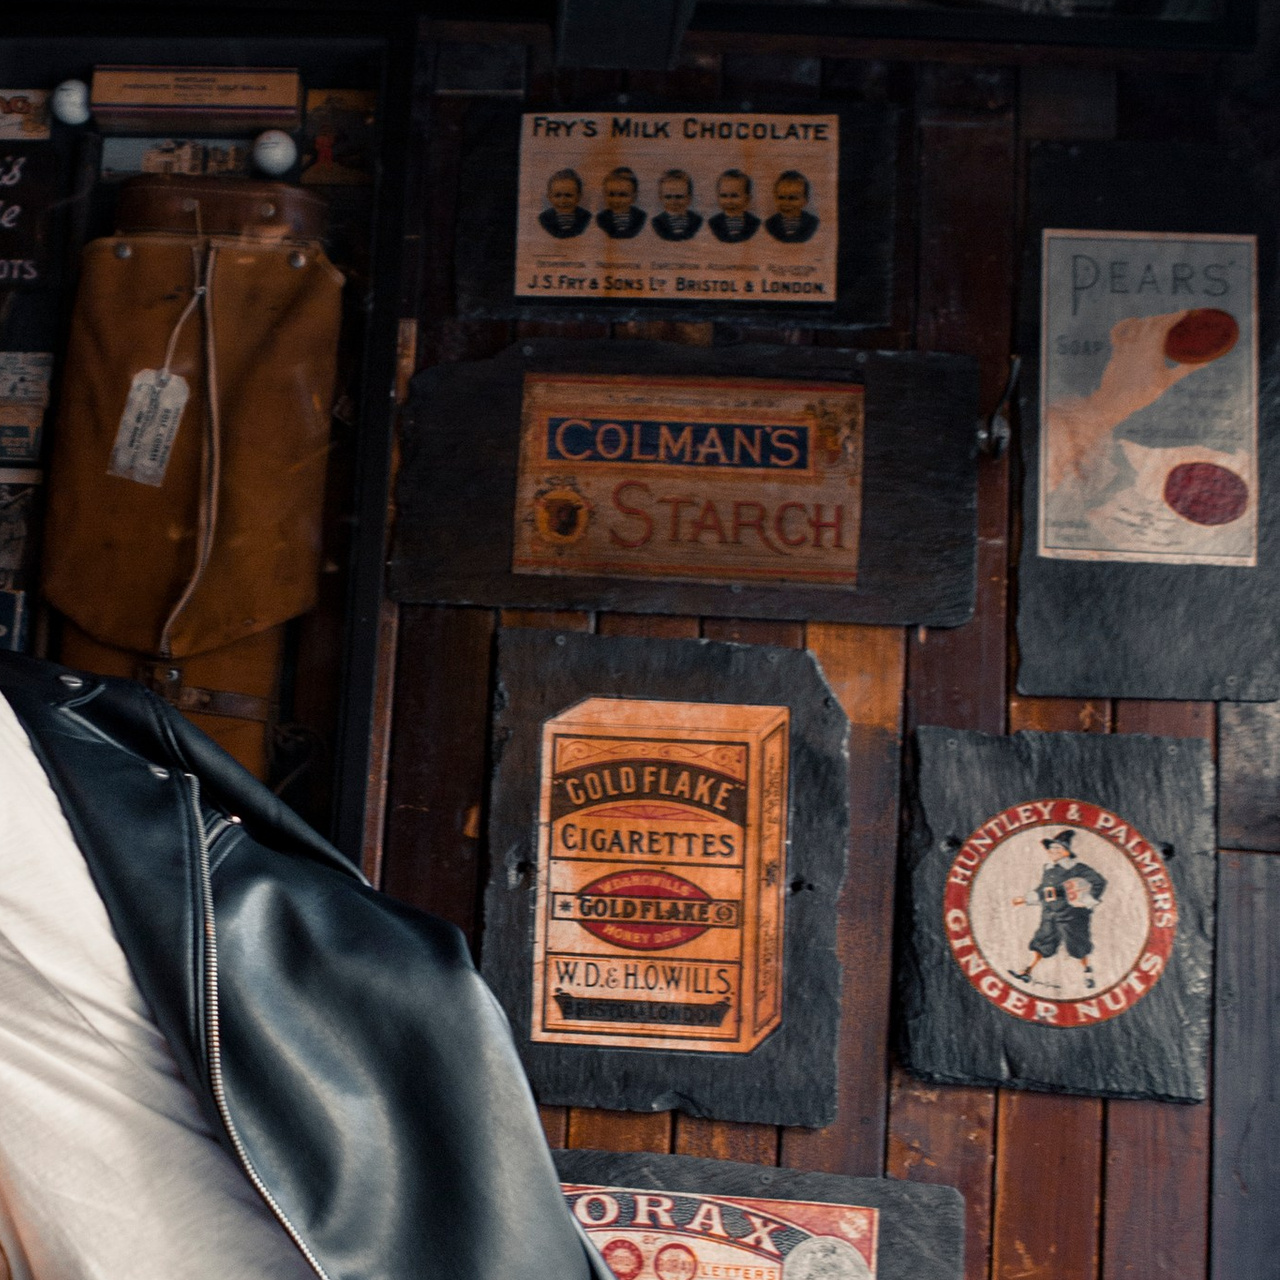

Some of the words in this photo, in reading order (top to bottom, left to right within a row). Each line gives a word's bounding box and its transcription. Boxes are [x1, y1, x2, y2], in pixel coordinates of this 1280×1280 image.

[532, 116, 598, 138] FRY'S
[612, 117, 670, 139] MILK
[683, 117, 830, 141] CHOCOLATE
[604, 276, 644, 292] SONS
[676, 276, 737, 293] BRISTOL
[554, 419, 801, 468] COLMAN'S
[610, 480, 844, 555] STARCH
[561, 823, 735, 858] CIGARETTES
[950, 801, 1056, 887] HUNTLEY
[1066, 803, 1081, 822] &
[1095, 812, 1174, 929] PALMERS
[579, 898, 636, 919] GOLD
[640, 901, 710, 922] FLAKE
[945, 908, 1060, 1023] GINGER
[1074, 951, 1164, 1022] NUTS
[572, 1192, 788, 1257] ORAX
[700, 1265, 776, 1280] LETTERS
